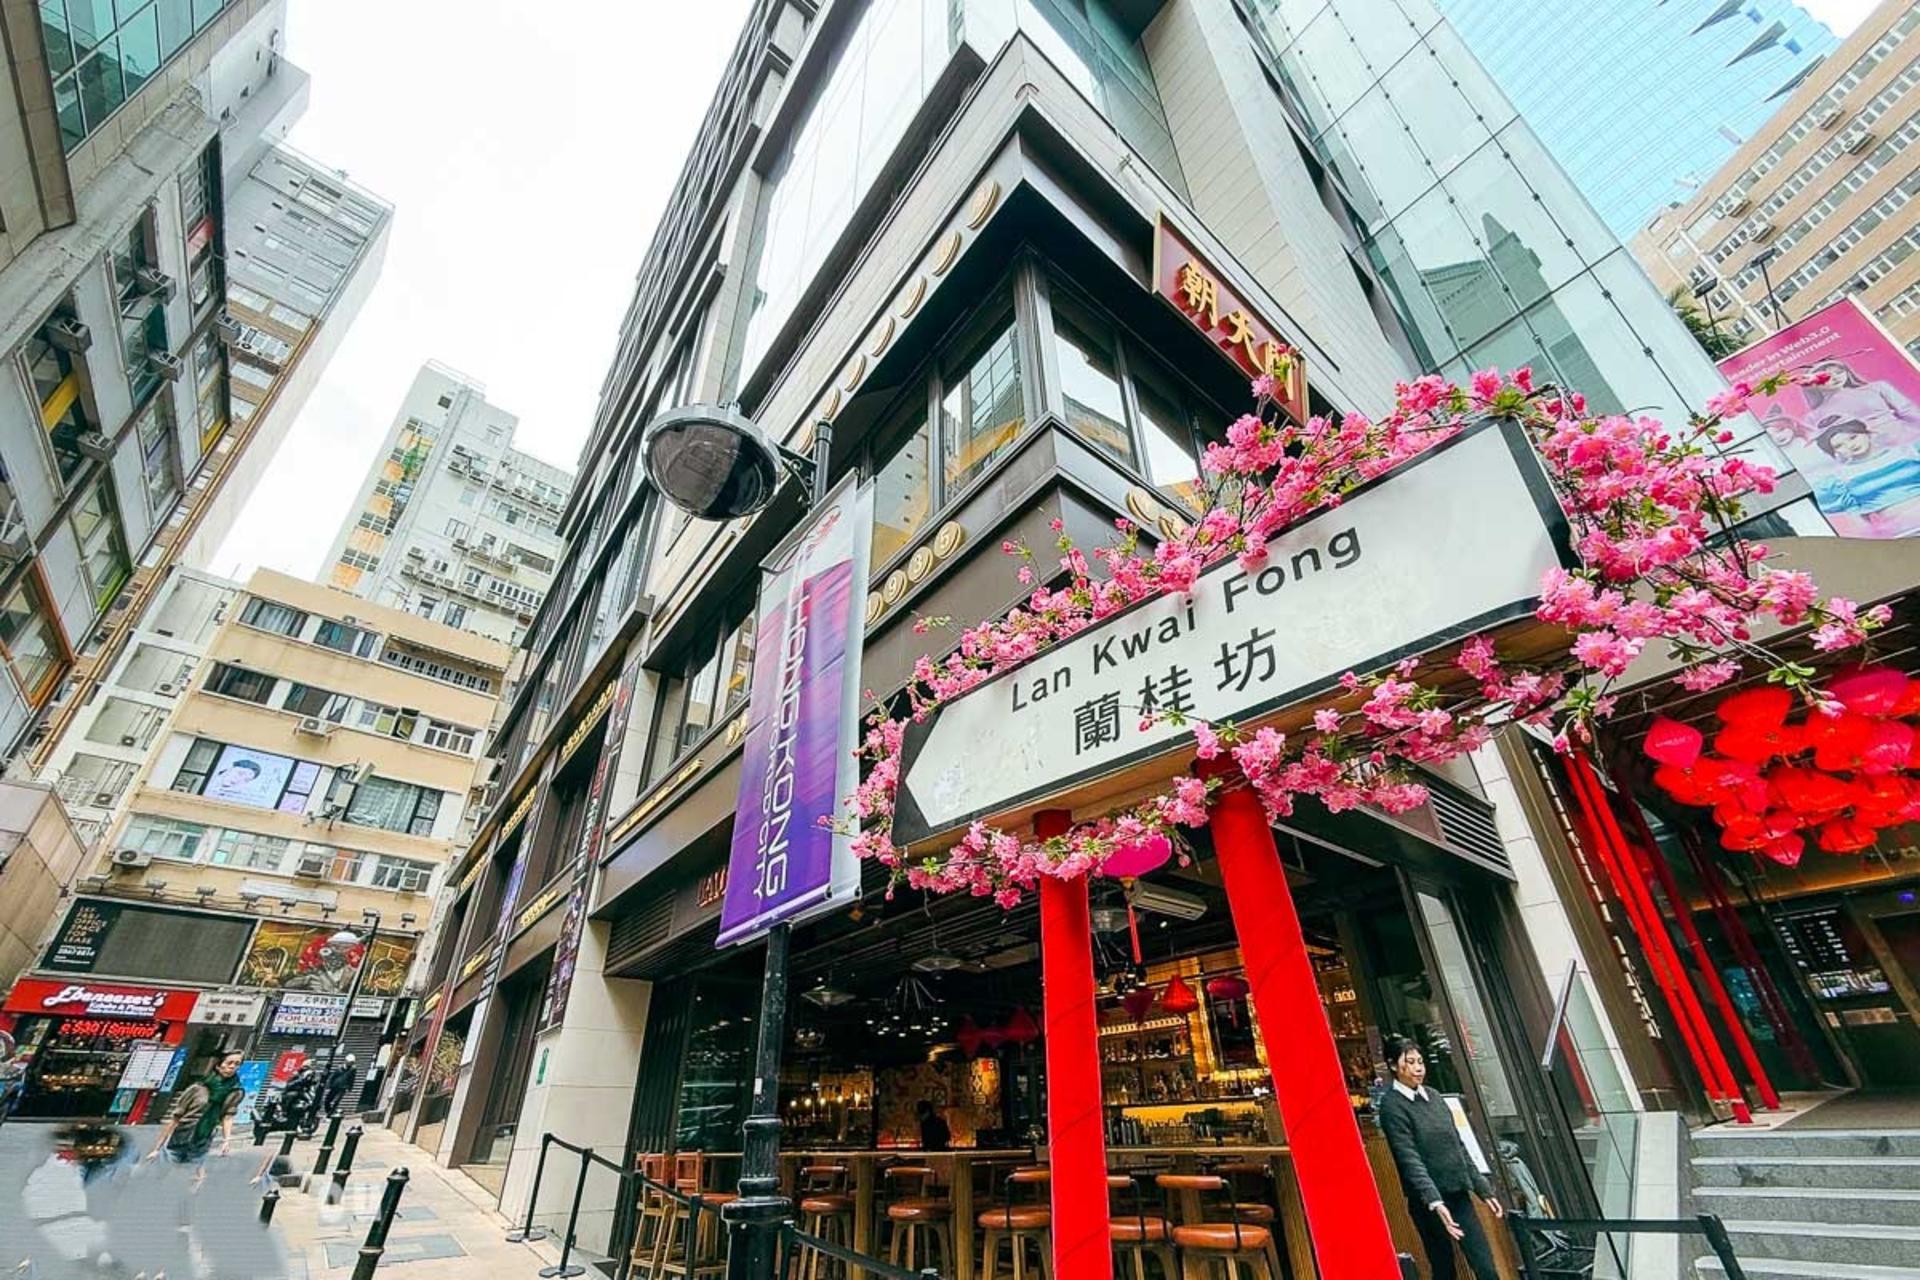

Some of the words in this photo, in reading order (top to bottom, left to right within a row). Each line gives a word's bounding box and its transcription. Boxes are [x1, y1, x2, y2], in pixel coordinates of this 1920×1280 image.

[781, 594, 811, 730] HONG
[1011, 665, 1071, 713] Lan
[1093, 598, 1197, 675] Kwai
[1223, 526, 1362, 614] Fong
[1074, 626, 1277, 756] 蘭桂坊
[753, 820, 769, 900] CITY
[766, 731, 798, 897] KONG
[276, 1012, 302, 1024] FOR
